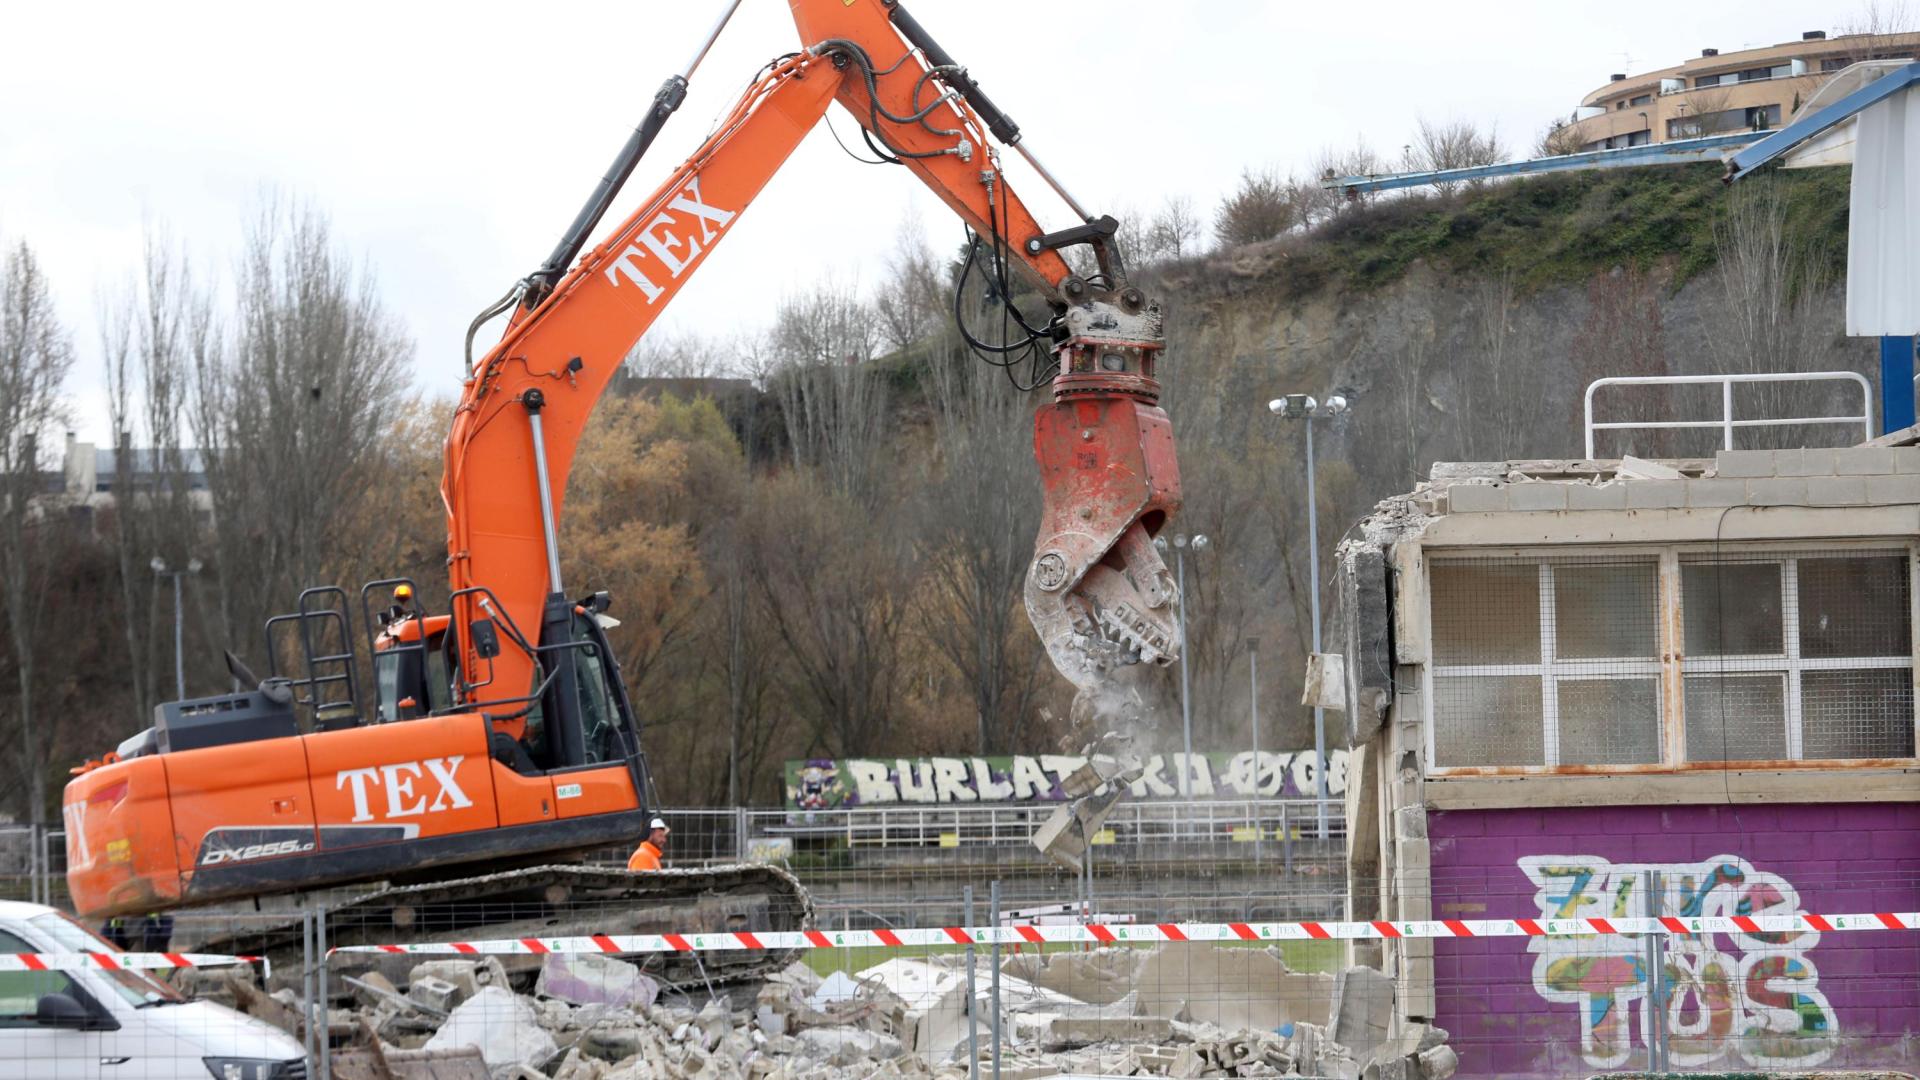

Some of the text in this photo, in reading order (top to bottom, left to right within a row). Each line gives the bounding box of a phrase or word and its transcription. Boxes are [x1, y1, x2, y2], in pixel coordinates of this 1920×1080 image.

[604, 176, 736, 305] TEX
[336, 755, 474, 823] TEX
[1564, 920, 1584, 930] TEX
[1708, 919, 1727, 929] TEX
[1853, 916, 1872, 926] TEX
